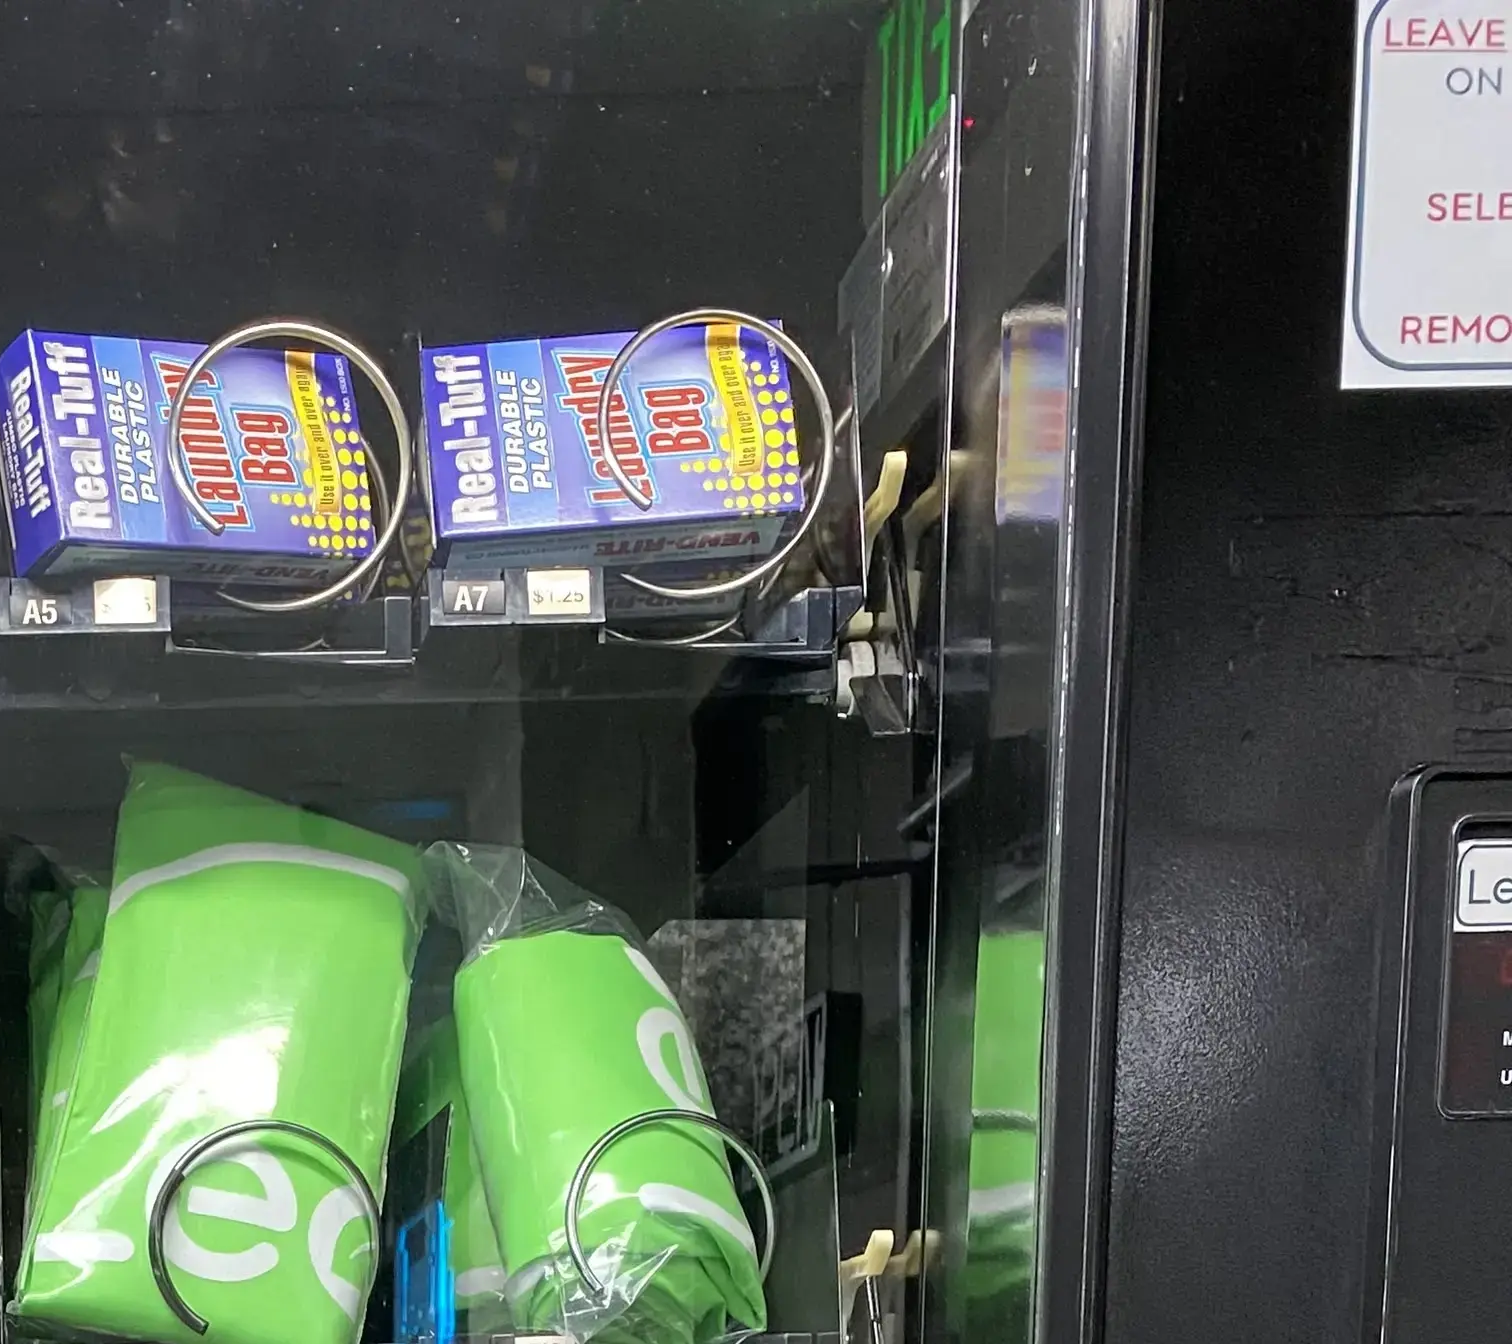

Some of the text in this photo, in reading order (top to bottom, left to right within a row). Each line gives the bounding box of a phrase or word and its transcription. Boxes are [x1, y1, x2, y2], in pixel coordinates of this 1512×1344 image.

[1386, 18, 1505, 47] LEAVE
[1446, 67, 1503, 95] ON
[1401, 314, 1512, 344] REMO
[10, 366, 52, 519] Real-Tuff
[43, 341, 114, 530] Real-Tuff
[101, 367, 140, 505] DURABLE
[125, 379, 160, 504] PLASTIC
[156, 361, 248, 526] Laundry
[234, 410, 297, 483] Bag
[302, 395, 335, 505] Use it over and over
[433, 354, 498, 523] Real-Tuff
[496, 369, 530, 493] DURABLE
[525, 376, 553, 489] PLASTIC
[556, 354, 654, 503] Laundry
[644, 386, 710, 454] Bag
[723, 363, 756, 467] Use it over and over
[22, 599, 58, 625] A5
[453, 585, 489, 612] A7
